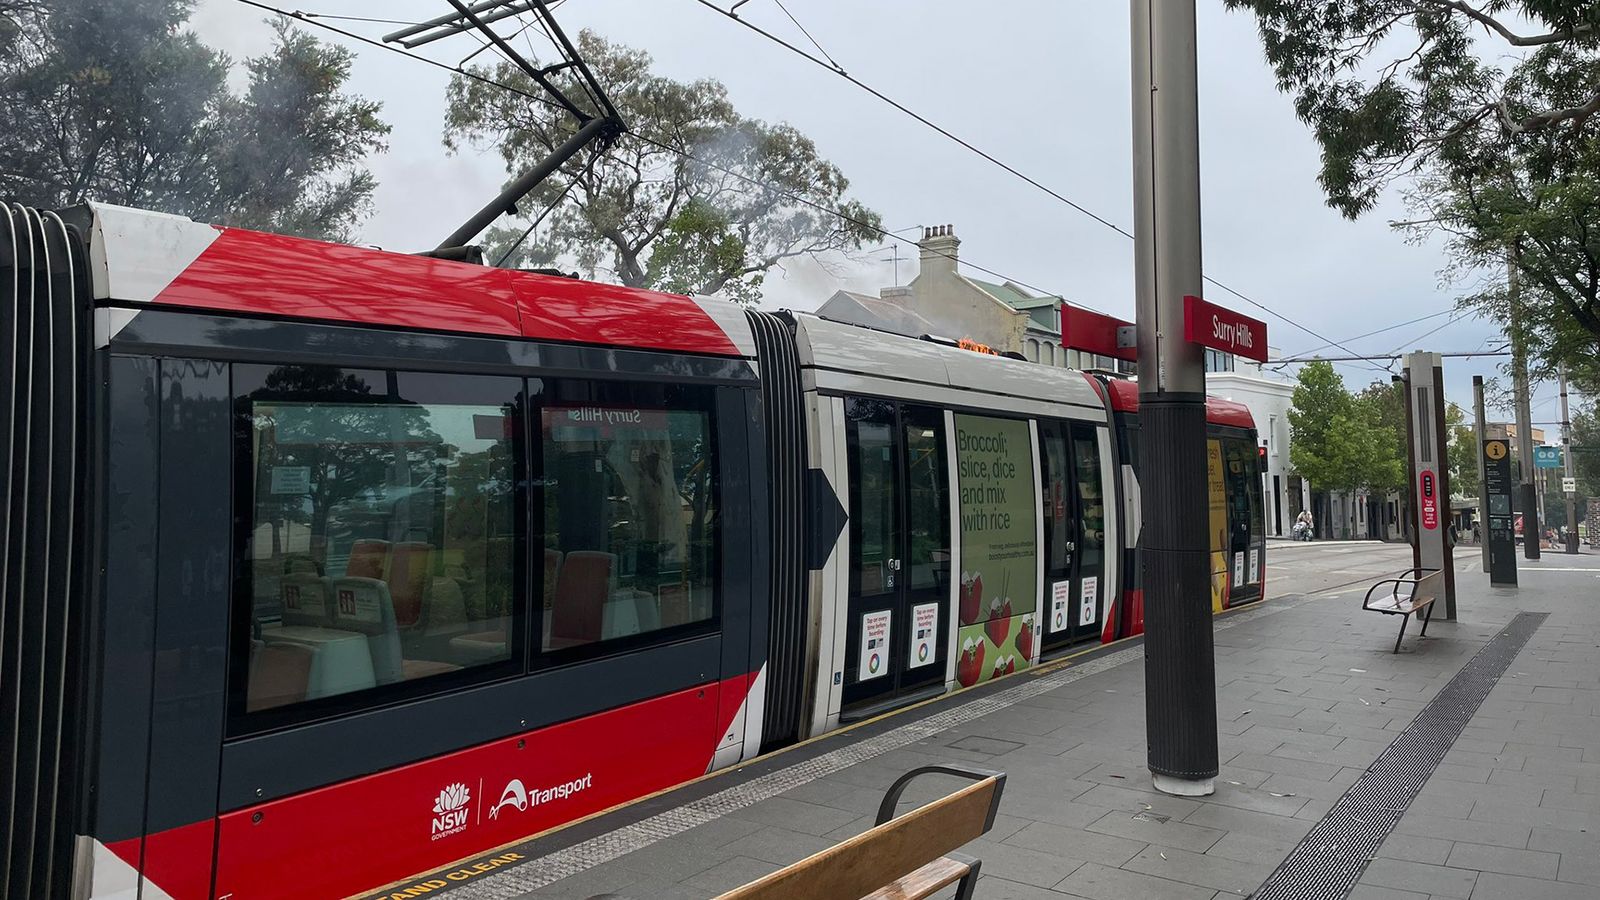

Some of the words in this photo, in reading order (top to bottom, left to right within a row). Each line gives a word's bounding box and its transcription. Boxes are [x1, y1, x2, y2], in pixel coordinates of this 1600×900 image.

[1213, 314, 1235, 349] Surry
[1236, 322, 1253, 348] Hills
[958, 429, 1008, 458] Broccoli;
[960, 456, 991, 482] slice,
[992, 457, 1016, 479] dice
[962, 483, 985, 505] and
[986, 481, 1007, 504] mix
[963, 509, 988, 532] with
[990, 508, 1010, 530] rice
[529, 772, 593, 807] Transport
[431, 807, 469, 834] NSW
[431, 824, 467, 841] GOVERNMENT
[446, 852, 525, 881] CLEAR
